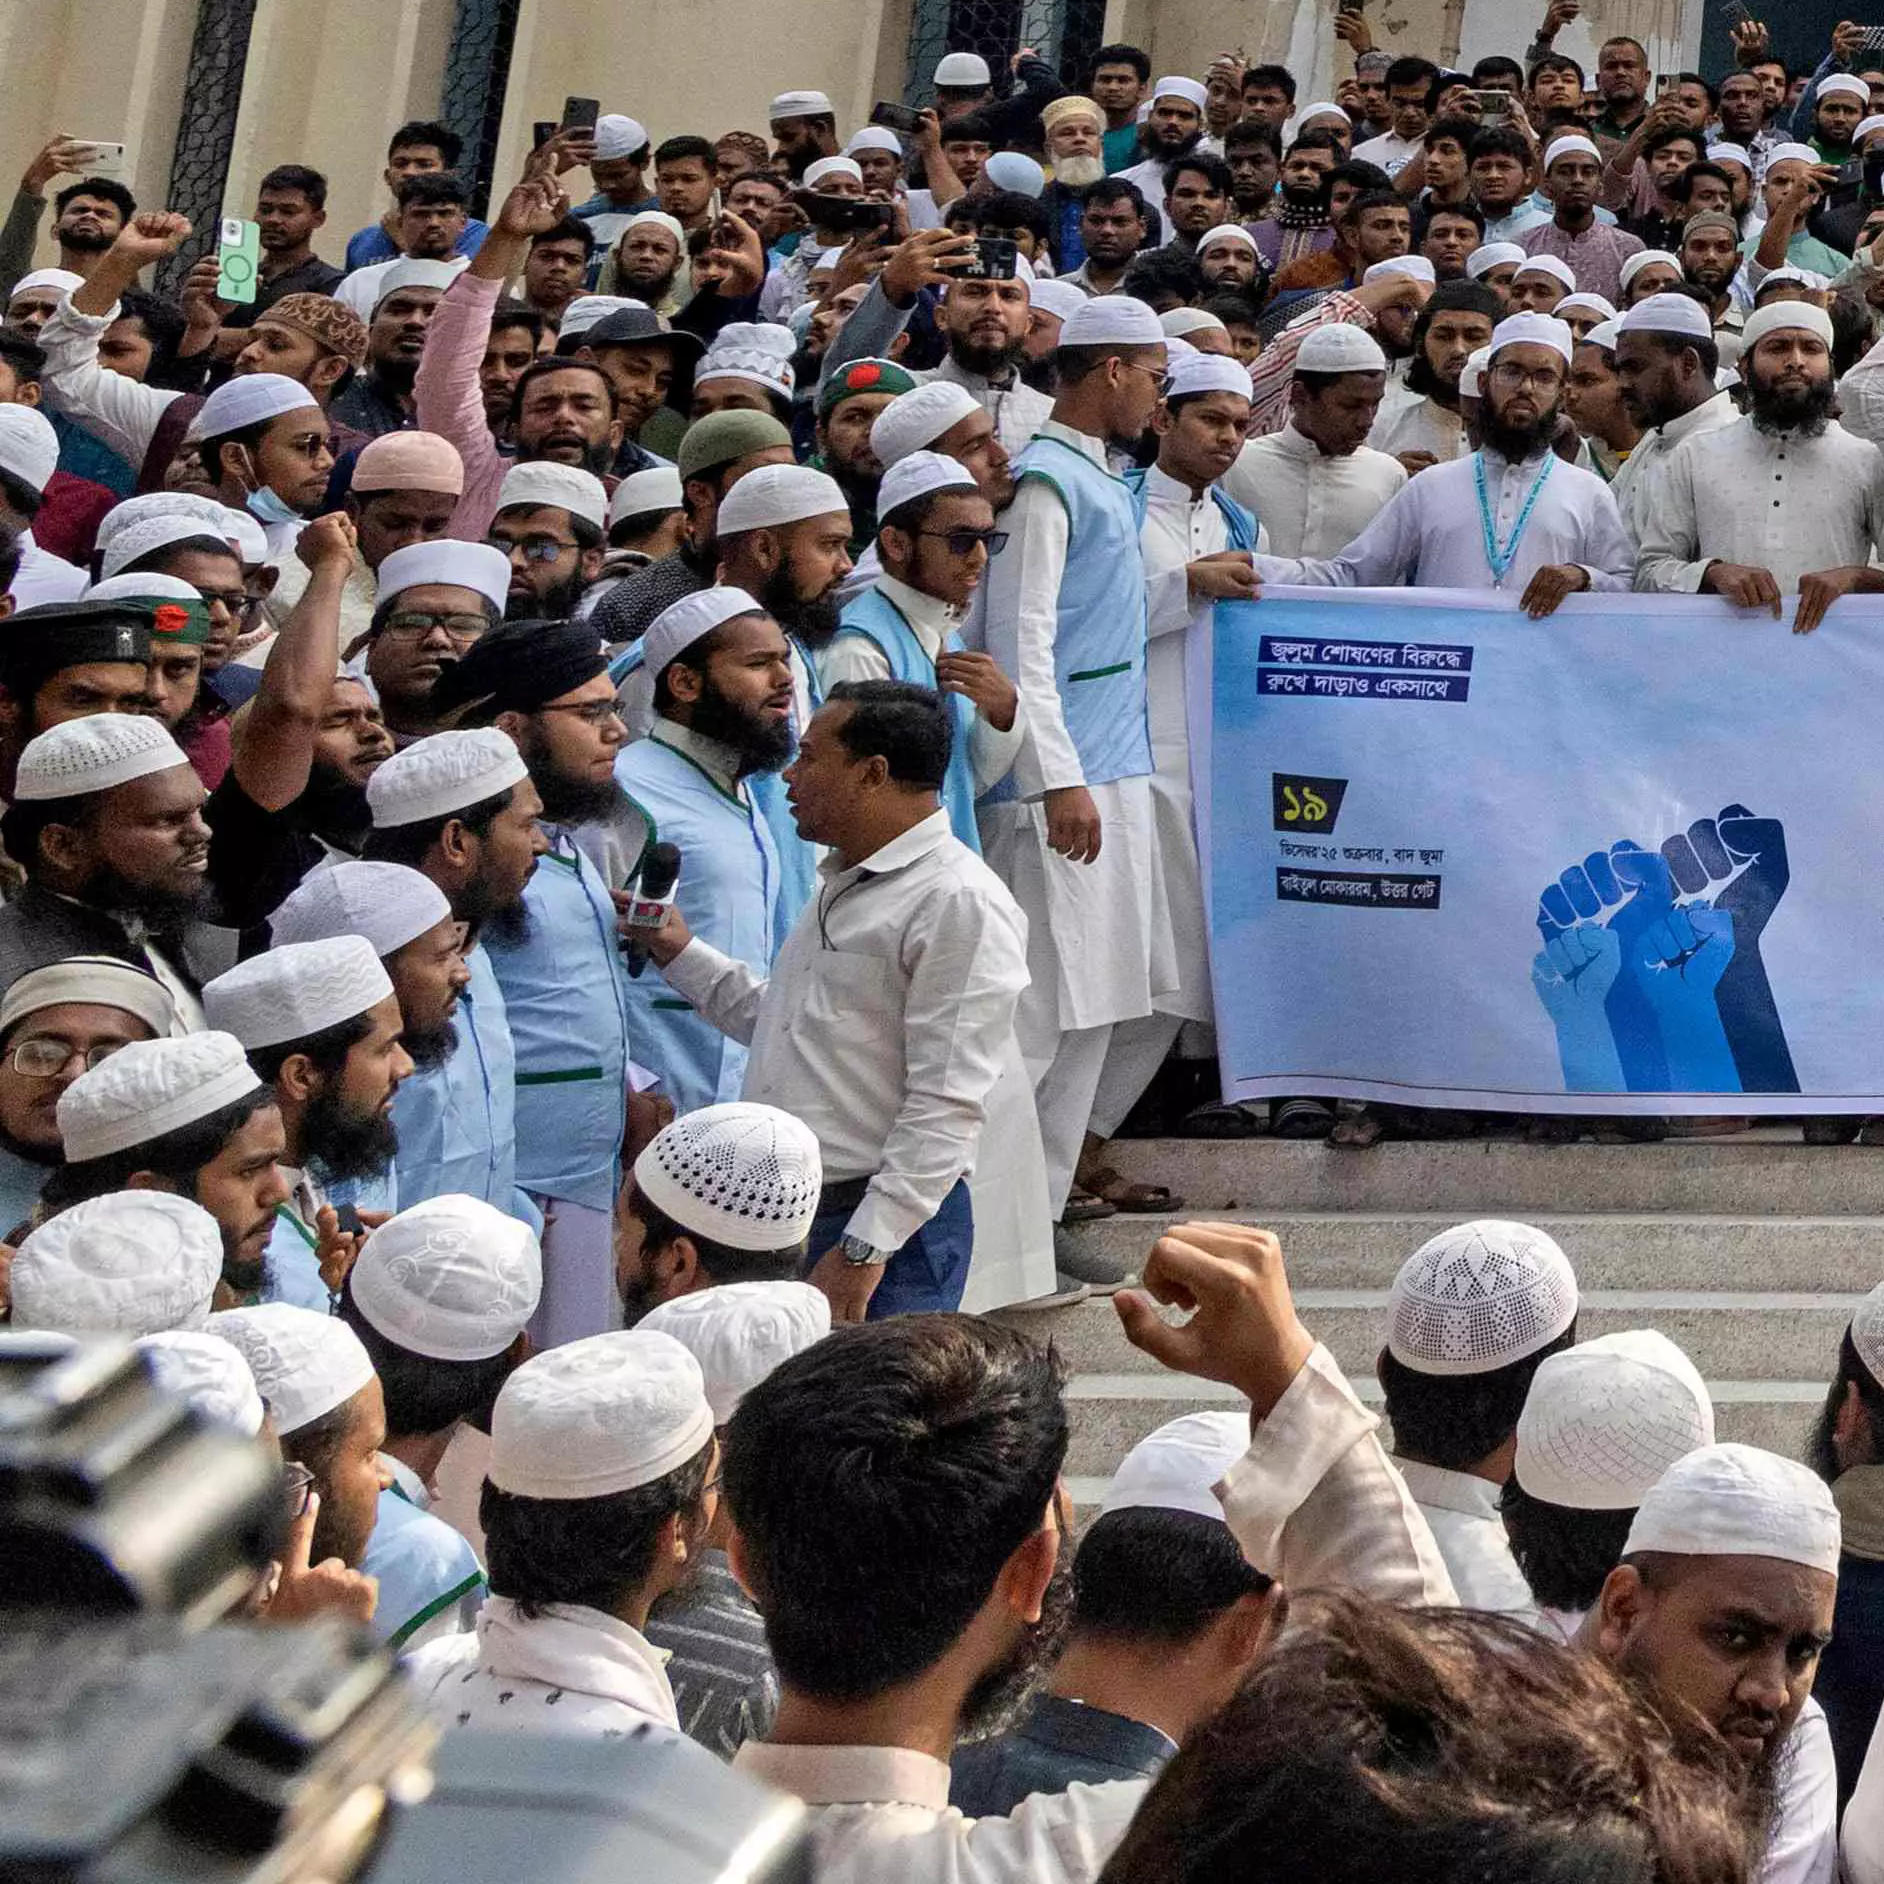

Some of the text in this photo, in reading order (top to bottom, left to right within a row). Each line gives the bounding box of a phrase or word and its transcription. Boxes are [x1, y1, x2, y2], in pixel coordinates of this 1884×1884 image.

[1269, 641, 1464, 669] জুলুম শোষণের বিরুদ্ধে
[1266, 672, 1309, 693] রুখে
[1375, 678, 1450, 699] একসাথে
[1283, 786, 1328, 821] ১৯
[1393, 847, 1415, 863] বাদ
